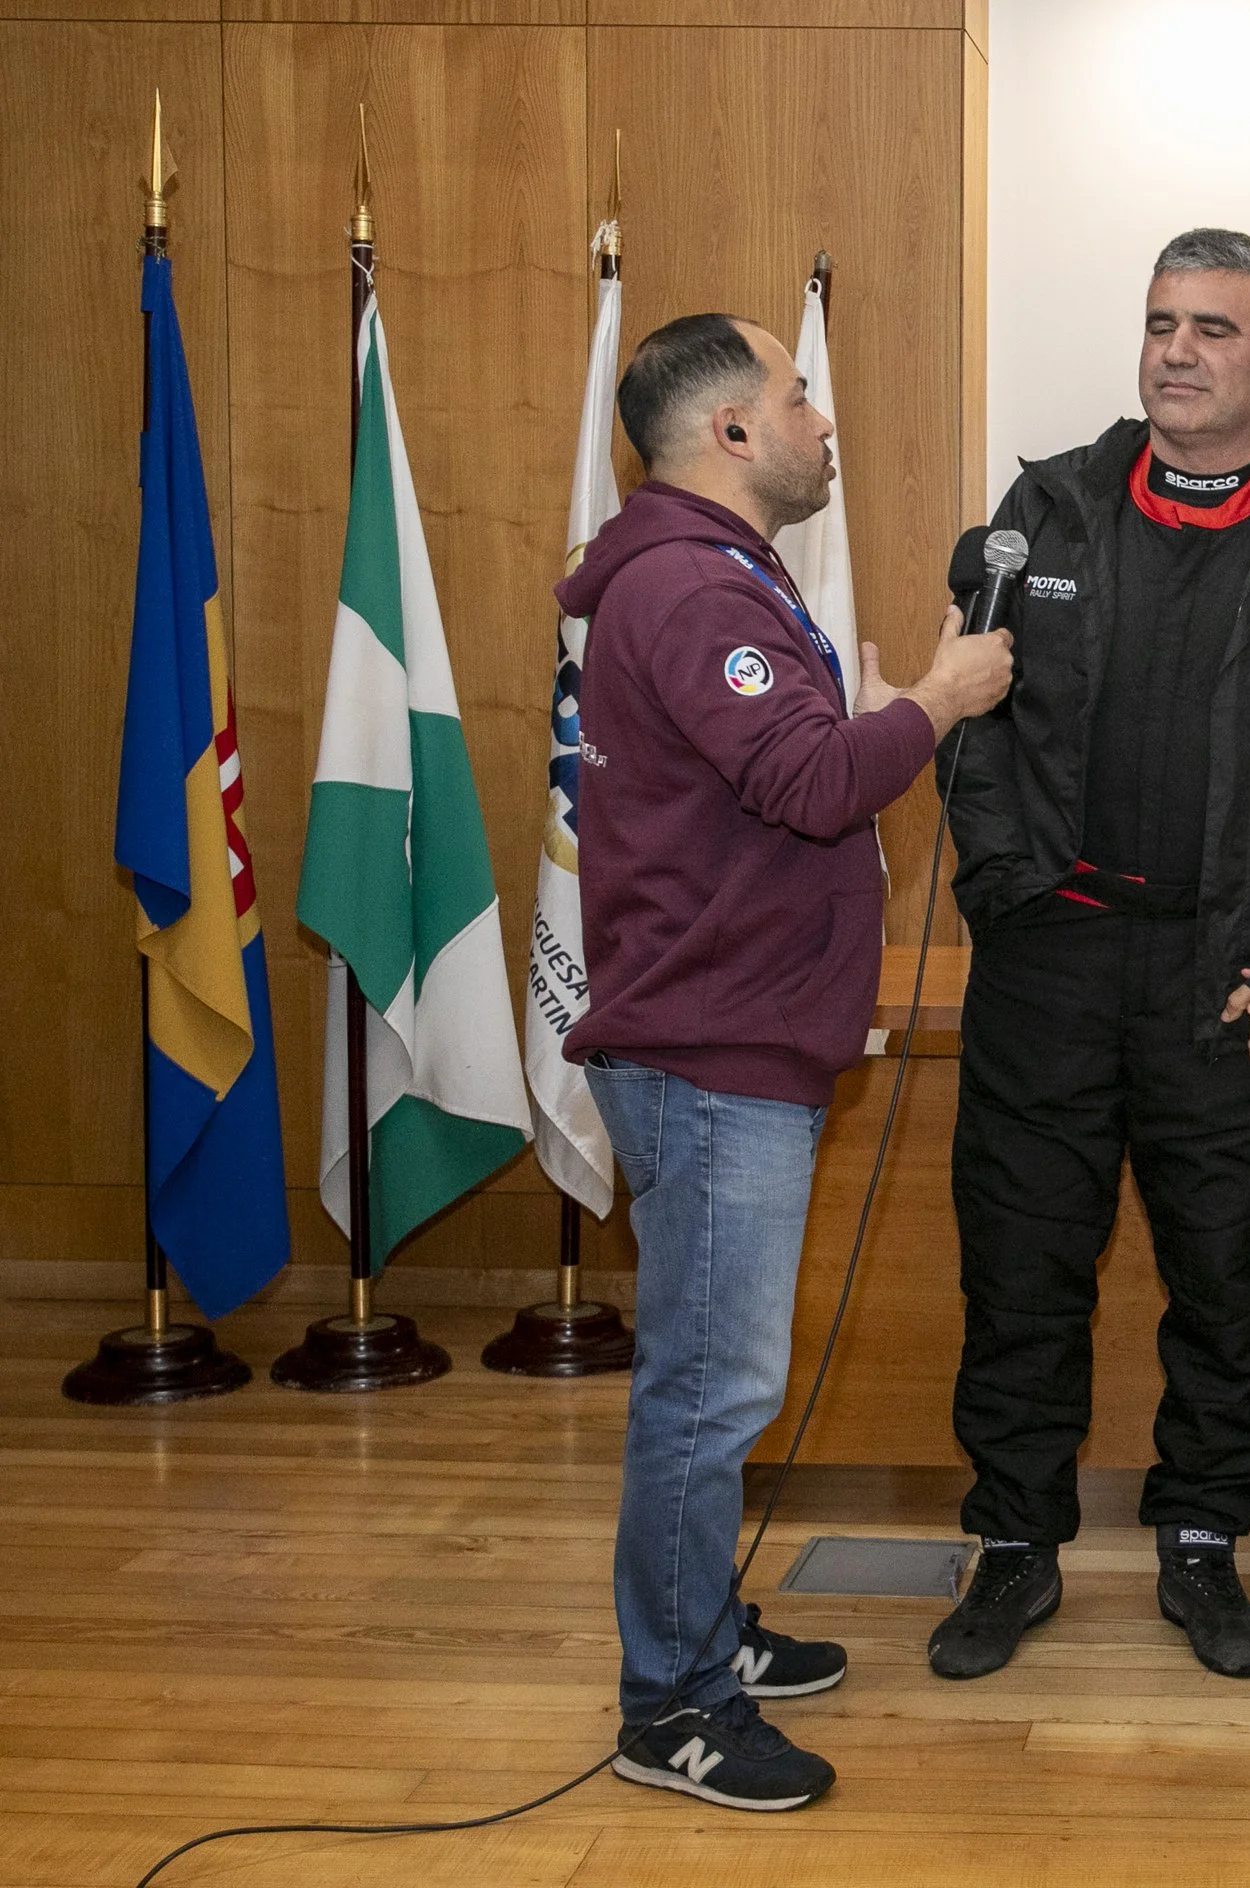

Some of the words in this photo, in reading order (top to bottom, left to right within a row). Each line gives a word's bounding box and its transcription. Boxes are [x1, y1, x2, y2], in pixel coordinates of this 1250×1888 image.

[1165, 471, 1239, 490] sparco
[1030, 589, 1051, 598] RALLY
[1052, 591, 1076, 600] SPIRIT
[738, 663, 761, 681] NP
[732, 1645, 773, 1684] N
[668, 1736, 724, 1783] N
